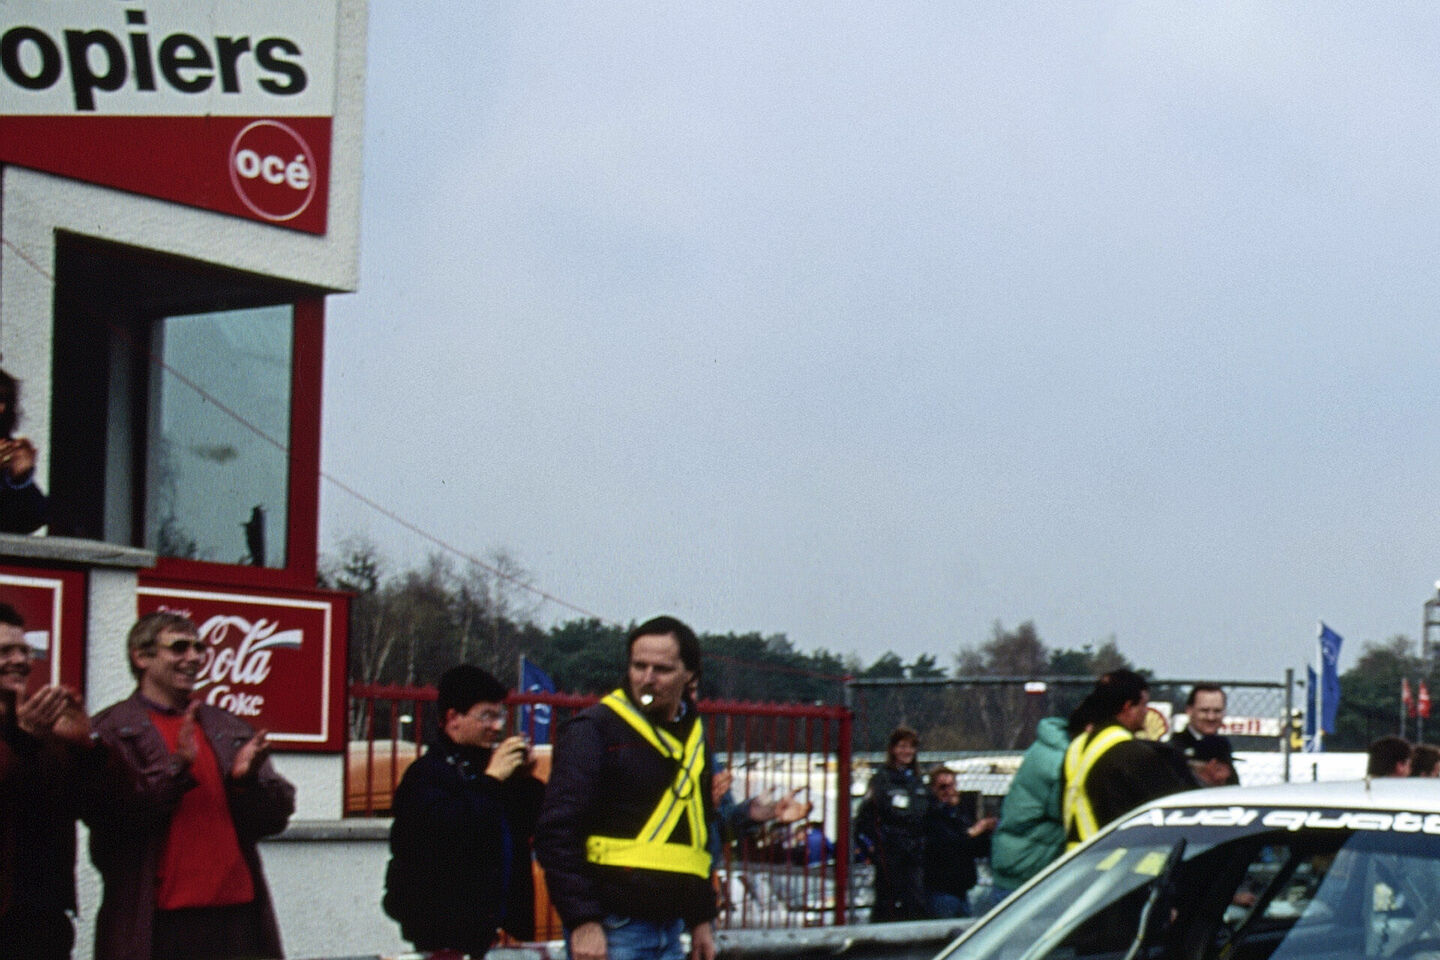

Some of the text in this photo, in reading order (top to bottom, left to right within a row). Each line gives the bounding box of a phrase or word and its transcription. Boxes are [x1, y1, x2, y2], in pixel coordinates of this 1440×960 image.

[0, 9, 309, 111] opiers
[235, 149, 311, 190] océ
[1118, 806, 1258, 831] Audi
